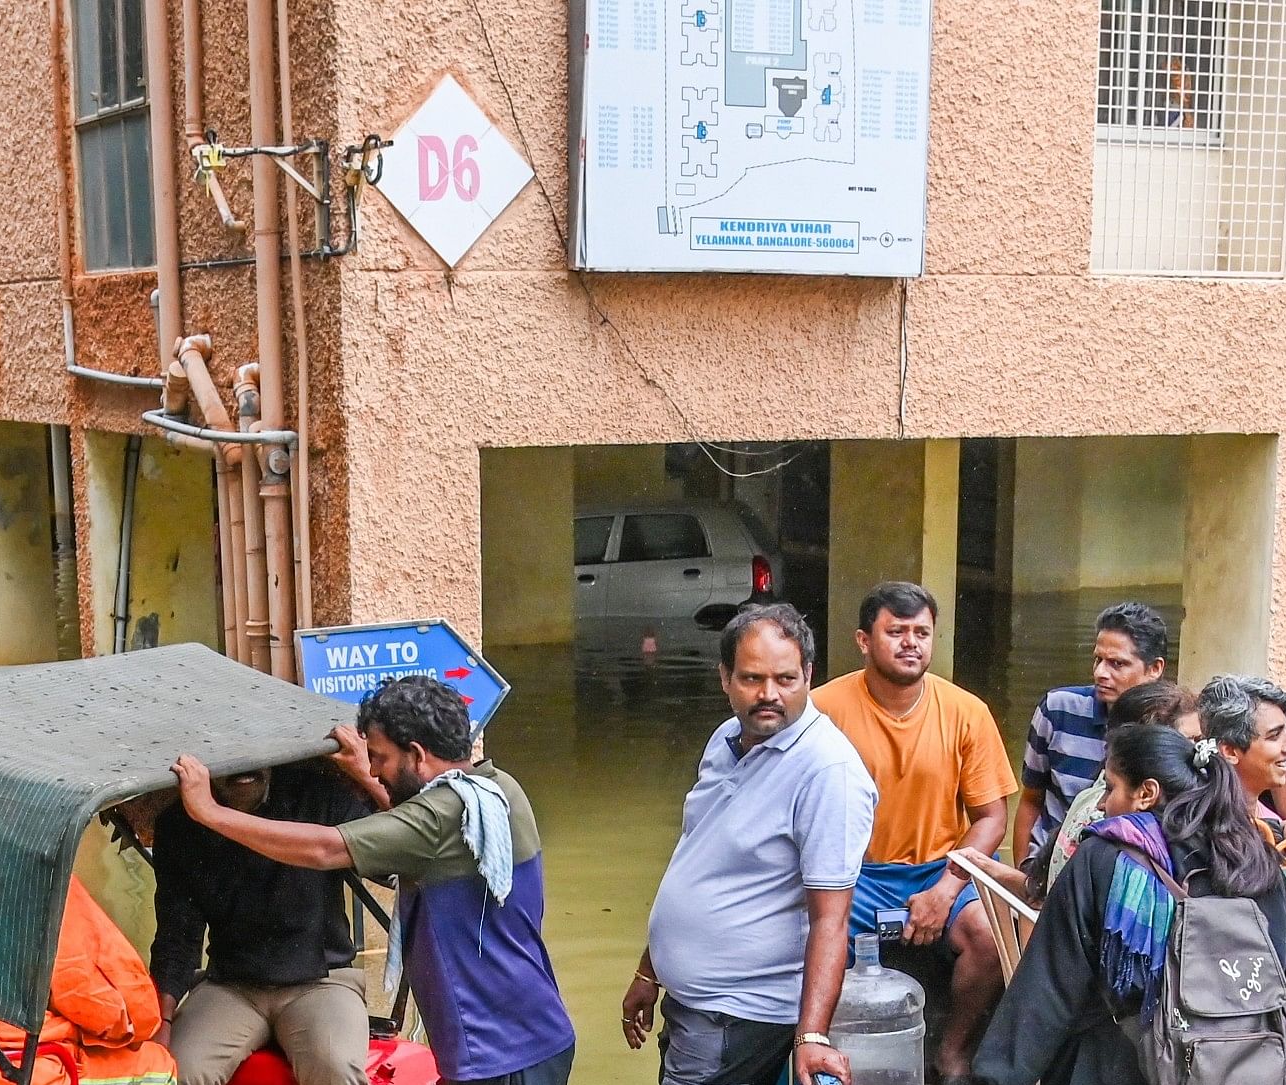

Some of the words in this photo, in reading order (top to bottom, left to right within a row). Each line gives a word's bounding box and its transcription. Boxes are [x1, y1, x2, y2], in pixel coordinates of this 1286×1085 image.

[417, 134, 480, 202] D6
[720, 220, 787, 233] KENDRIYA
[791, 222, 832, 234] VIHAR
[757, 236, 855, 249] BANGALORE-560064
[326, 643, 378, 668] WAY
[385, 641, 418, 663] TO
[312, 673, 376, 694] VISITOR'S
